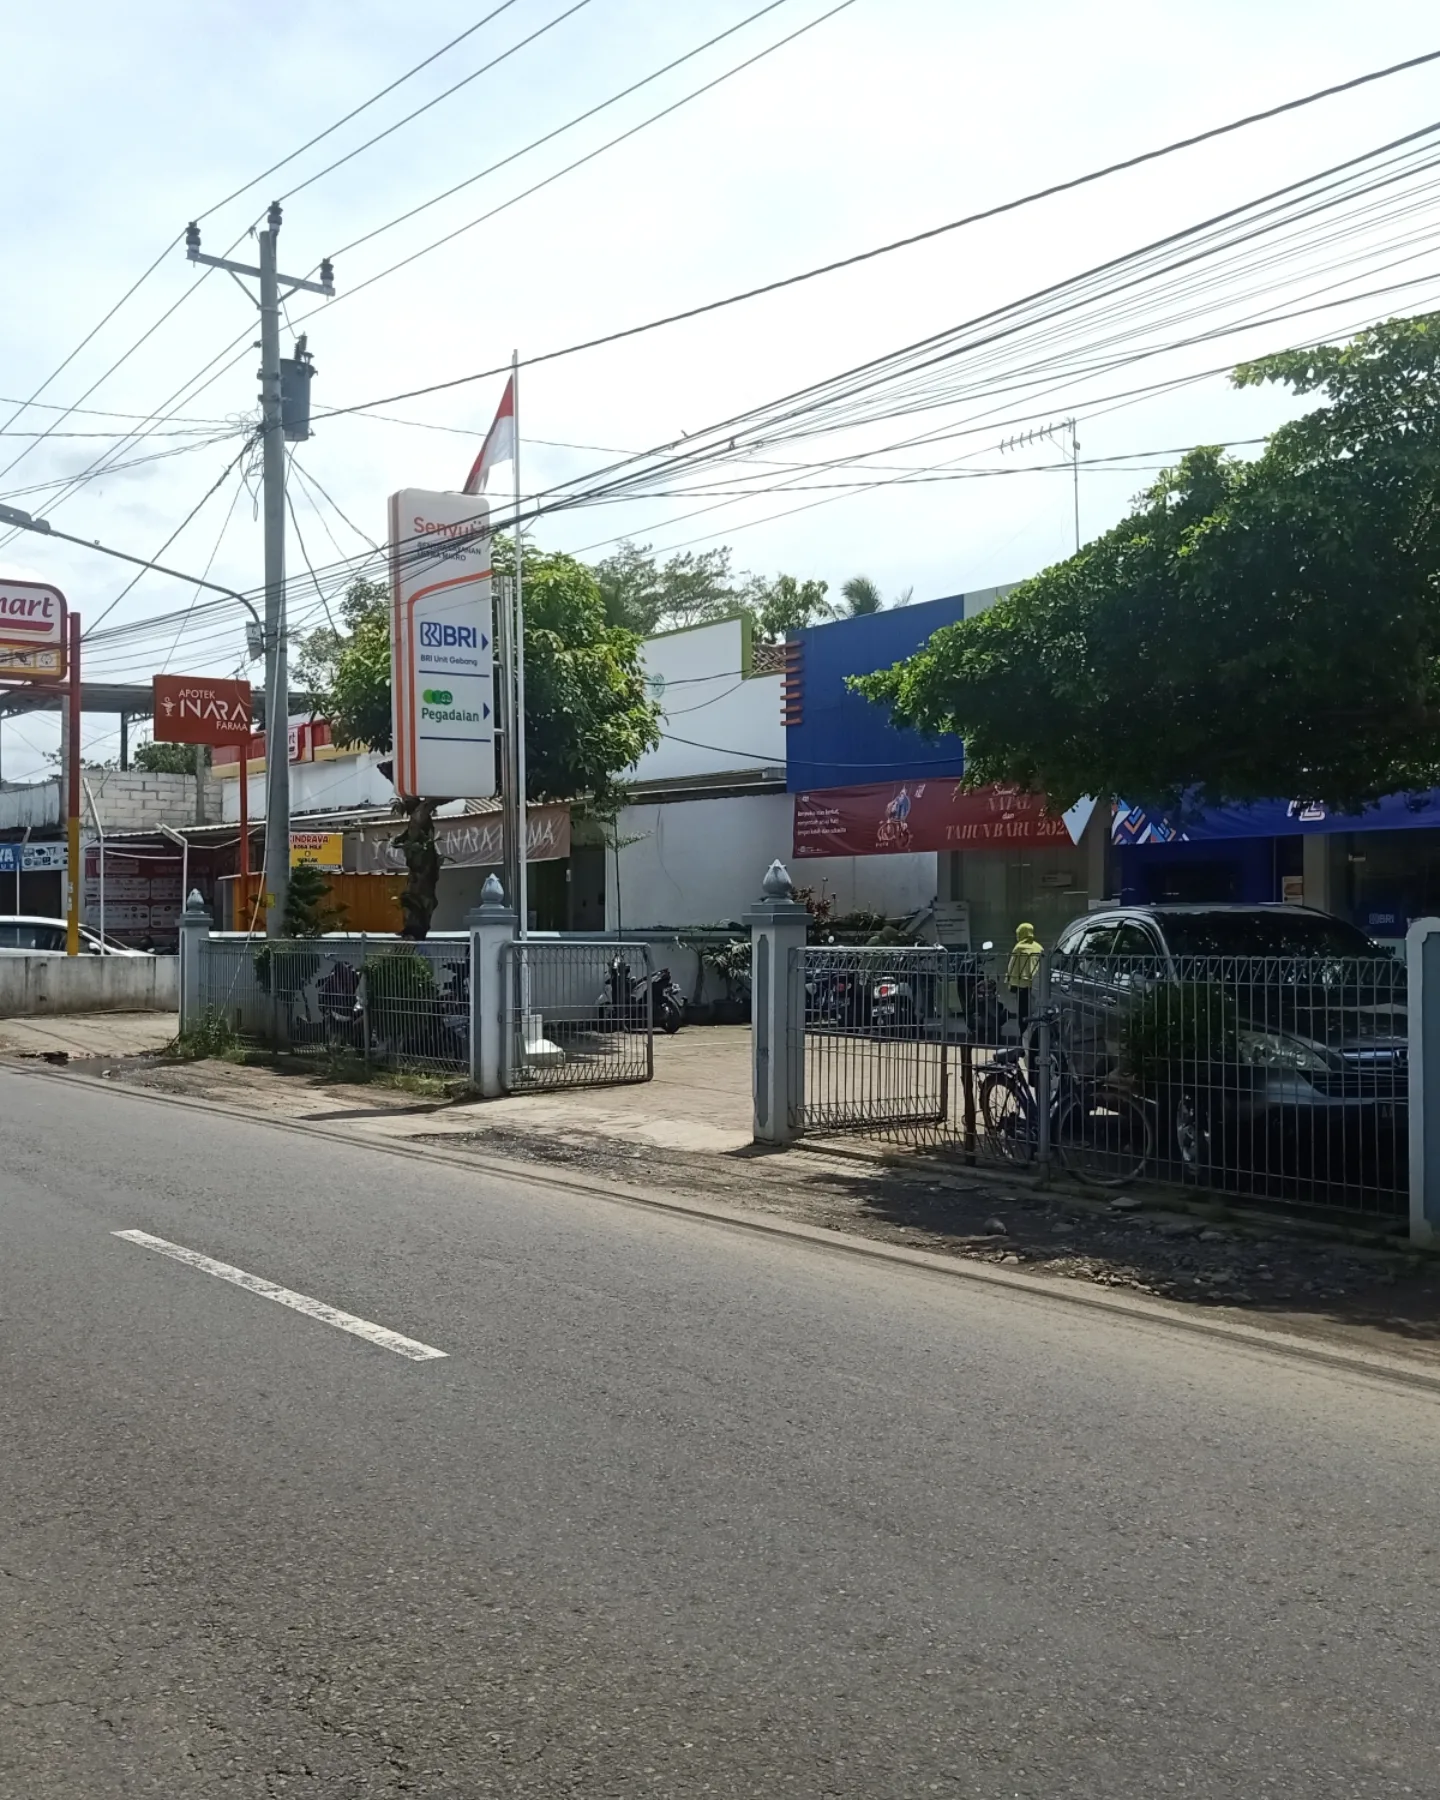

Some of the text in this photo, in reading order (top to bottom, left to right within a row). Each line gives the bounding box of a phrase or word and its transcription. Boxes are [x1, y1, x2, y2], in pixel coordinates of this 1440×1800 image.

[443, 625, 477, 648] BRI
[420, 654, 478, 667] BRI Unit Gebang
[178, 689, 216, 700] APOTEK
[180, 698, 249, 722] INARA
[421, 707, 480, 723] Pegadaian
[216, 721, 249, 732] FARMA
[1002, 811, 1015, 820] dan
[945, 820, 1072, 840] TAHUN BARU 202
[1379, 913, 1395, 924] BRI
